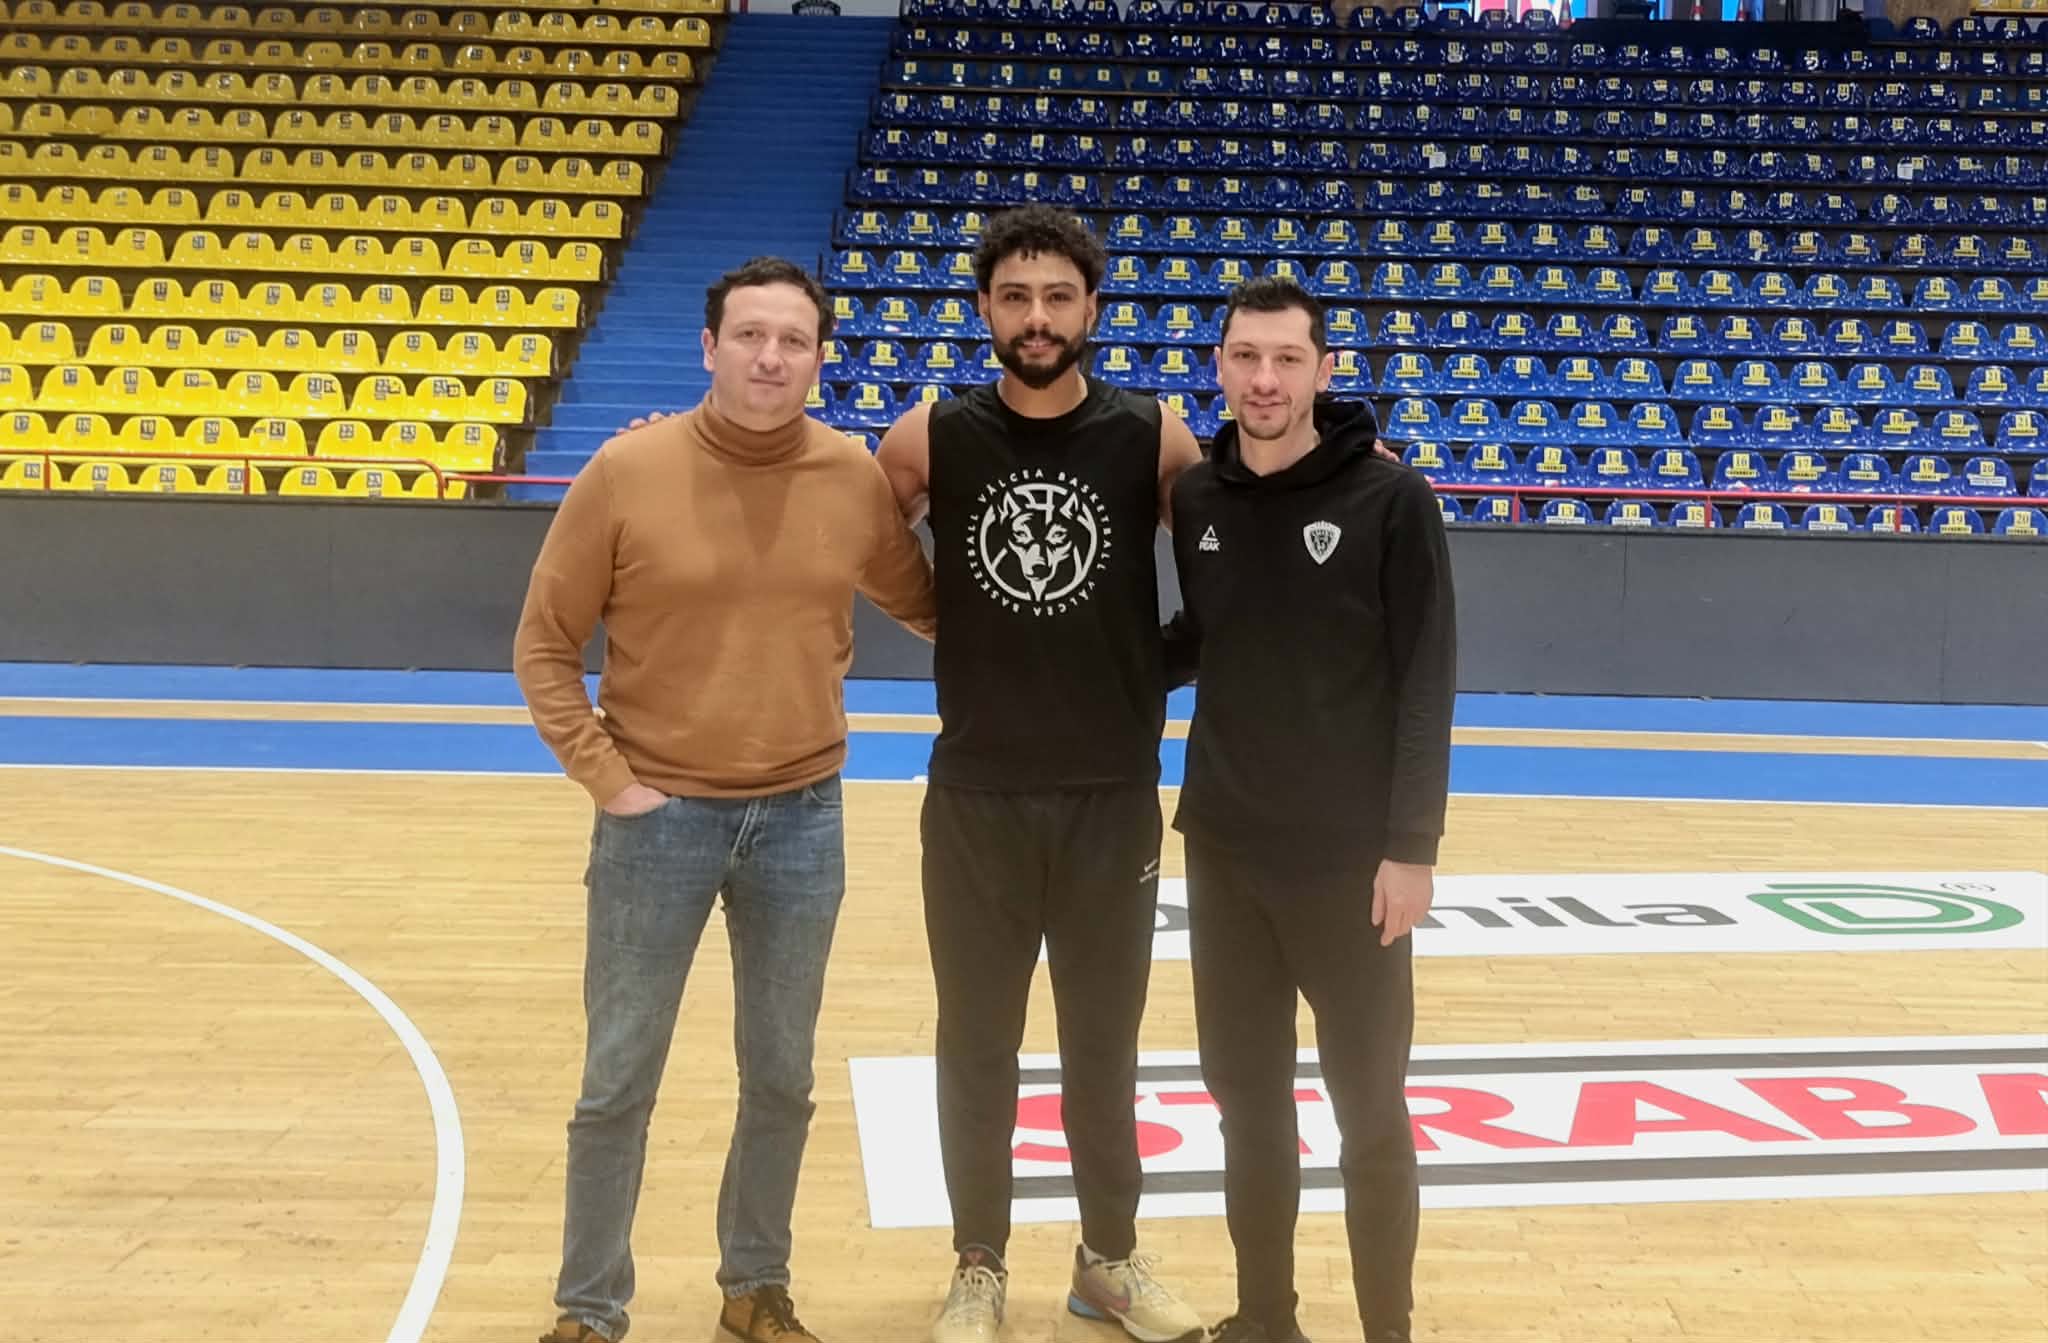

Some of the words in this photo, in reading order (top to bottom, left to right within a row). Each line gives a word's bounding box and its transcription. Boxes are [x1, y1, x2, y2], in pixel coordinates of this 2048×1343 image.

[1952, 417, 1961, 425] 20
[1486, 449, 1496, 457] 12
[1736, 455, 1747, 465] 16
[1983, 463, 1993, 472] 20
[161, 469, 175, 480] 20
[1495, 503, 1506, 513] 12
[1627, 507, 1637, 517] 14
[1691, 509, 1702, 519] 15
[1758, 509, 1769, 519] 16
[1823, 509, 1834, 519] 17
[1058, 471, 1112, 570] BASKETBALL
[2017, 514, 2028, 525] 20
[1199, 541, 1220, 551] PEAK
[966, 514, 1020, 613] BASKETBALL
